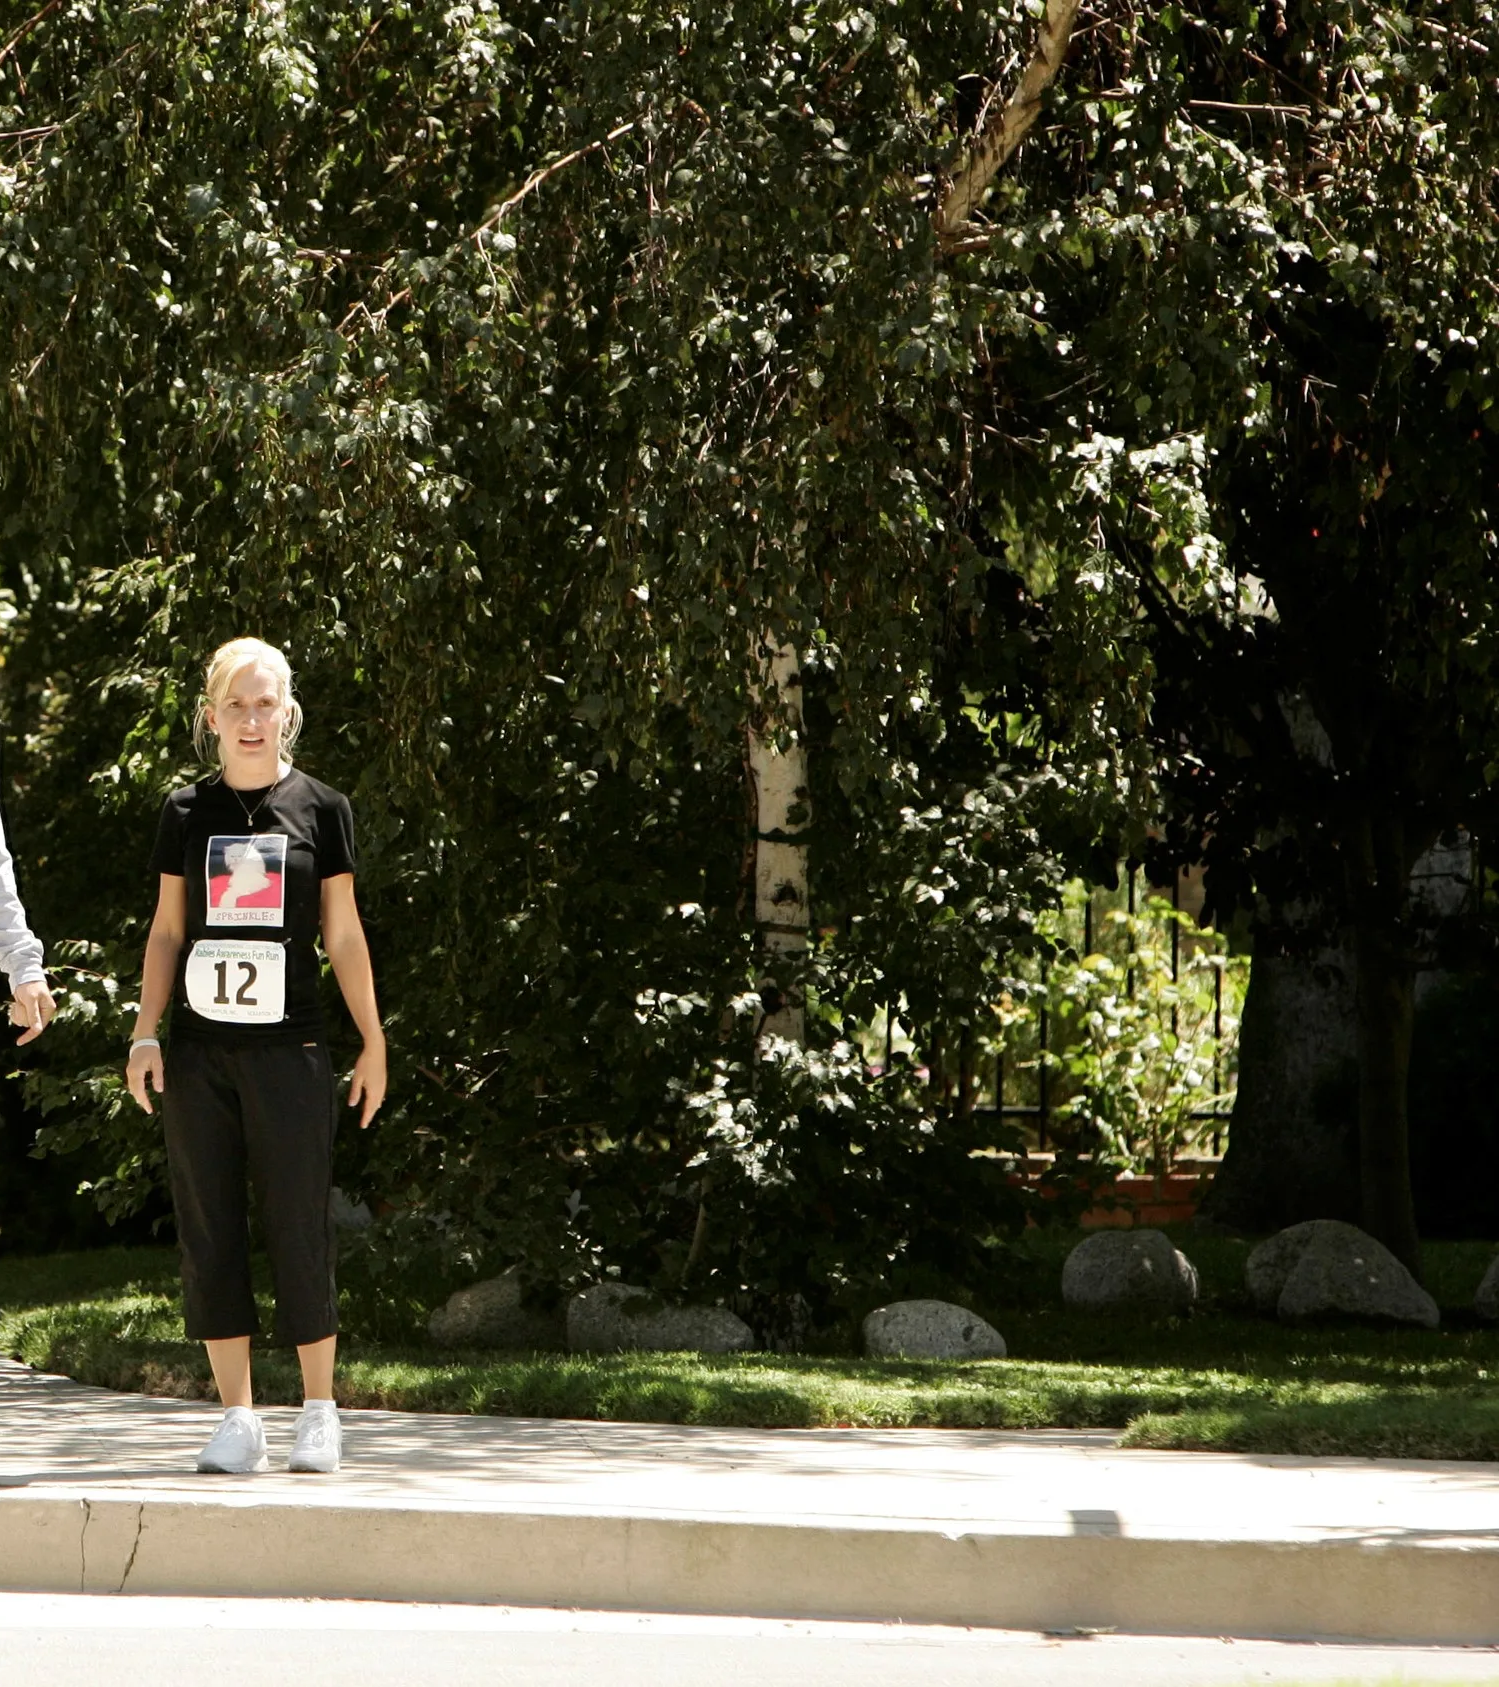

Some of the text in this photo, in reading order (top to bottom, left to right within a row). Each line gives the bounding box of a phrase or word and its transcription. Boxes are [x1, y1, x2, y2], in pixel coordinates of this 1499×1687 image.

[215, 911, 275, 921] SPRINKLES
[194, 947, 280, 961] Rabies Awareness Fun Run
[213, 961, 258, 1006] 12
